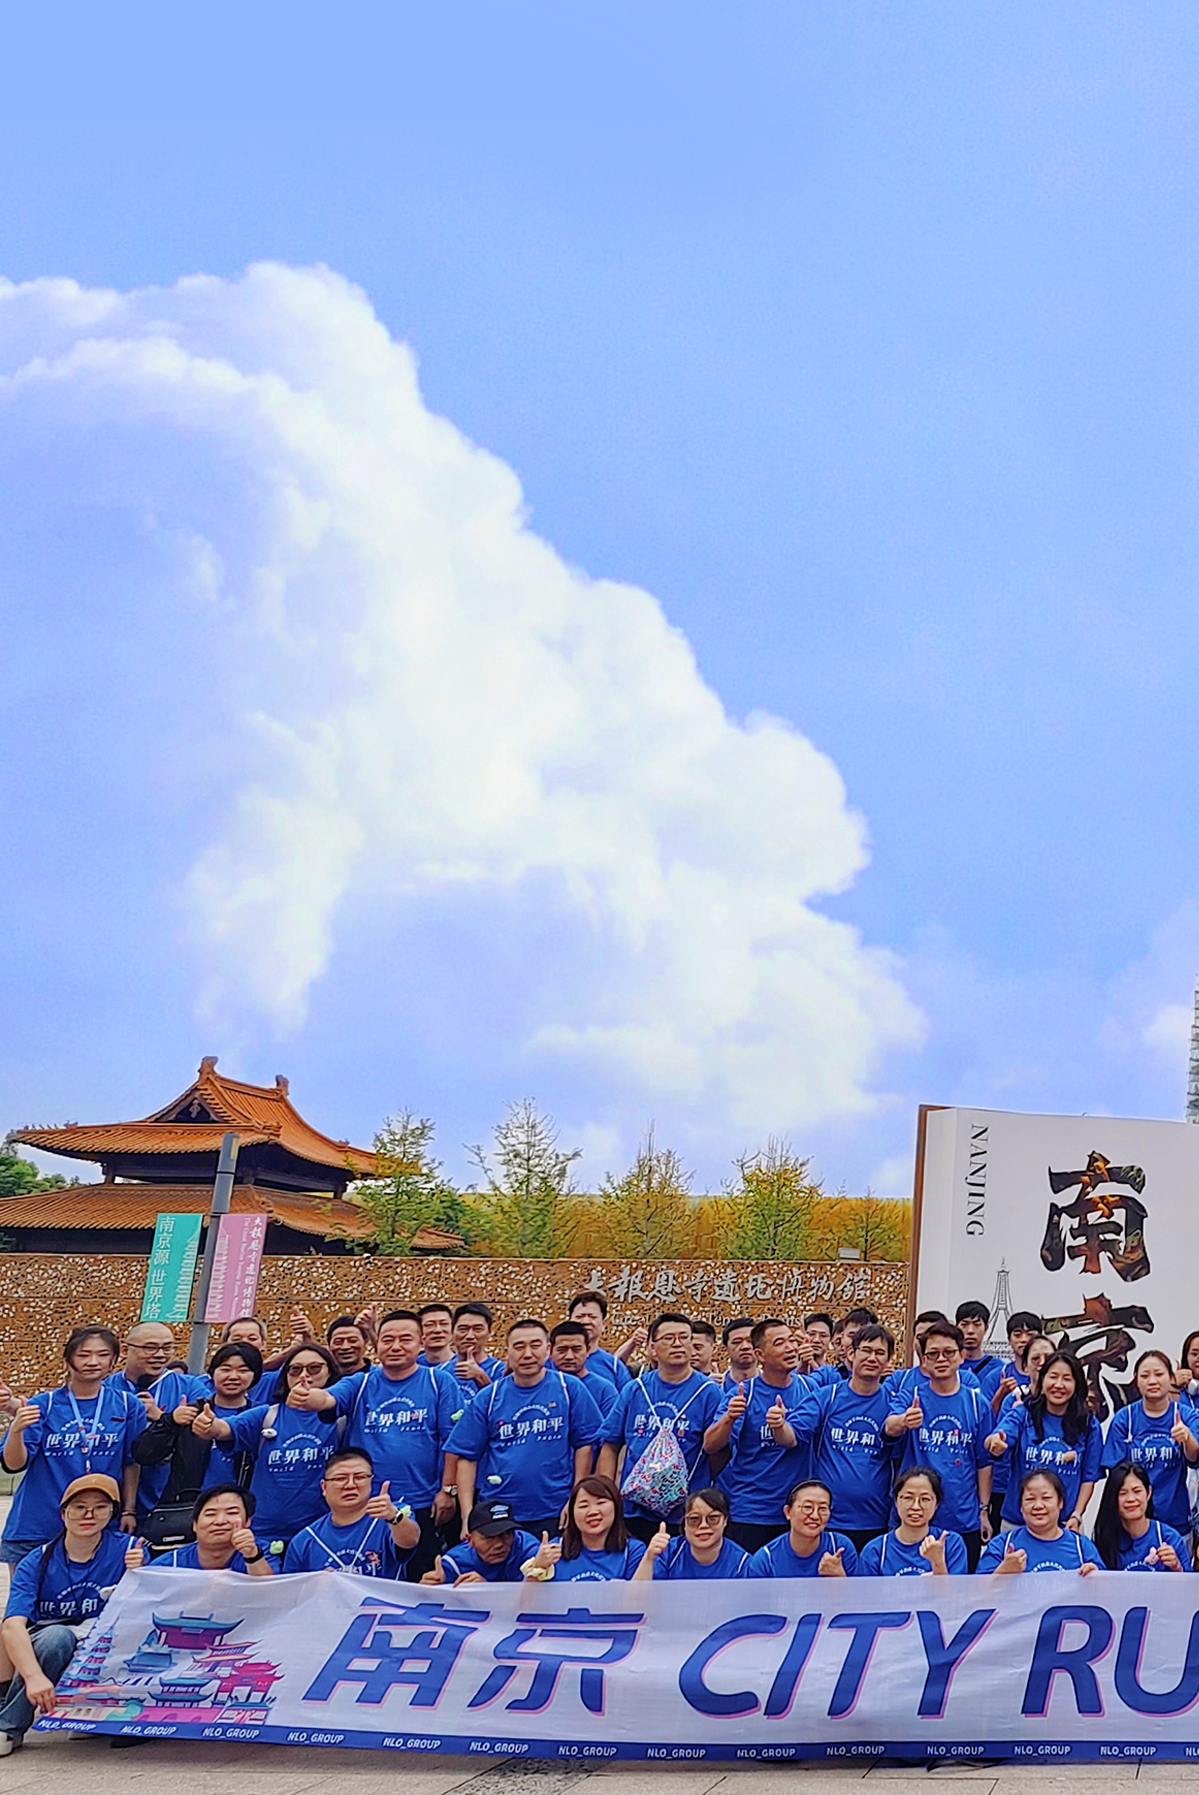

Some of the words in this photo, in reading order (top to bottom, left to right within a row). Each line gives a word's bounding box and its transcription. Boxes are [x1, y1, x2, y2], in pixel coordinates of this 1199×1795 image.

[965, 1124, 989, 1236] NANJING
[153, 1216, 177, 1265] 南京源
[143, 1269, 167, 1319] 世界塔
[366, 1408, 428, 1427] 世界和平
[500, 1417, 564, 1439] 世界和平
[919, 1428, 972, 1447] 世界和平
[268, 1446, 334, 1465] 世界和平
[302, 1596, 646, 1716] 南京
[678, 1607, 997, 1720] CITY
[202, 1727, 260, 1740] NLO_GROUP
[287, 1731, 345, 1744] NLO_GROUP
[383, 1737, 441, 1750] NLO_GROUP
[469, 1741, 529, 1754] NLO_GROUP
[558, 1746, 617, 1757] NLO_GROUP
[647, 1748, 706, 1759] NLO_GROUP
[737, 1748, 796, 1759] NLO_GROUP
[826, 1746, 885, 1757] NLO_GROUP
[927, 1746, 985, 1757] NLO_GROUP
[1014, 1746, 1071, 1757] NLO_GROUP
[1100, 1746, 1157, 1757] NLO_GROUP
